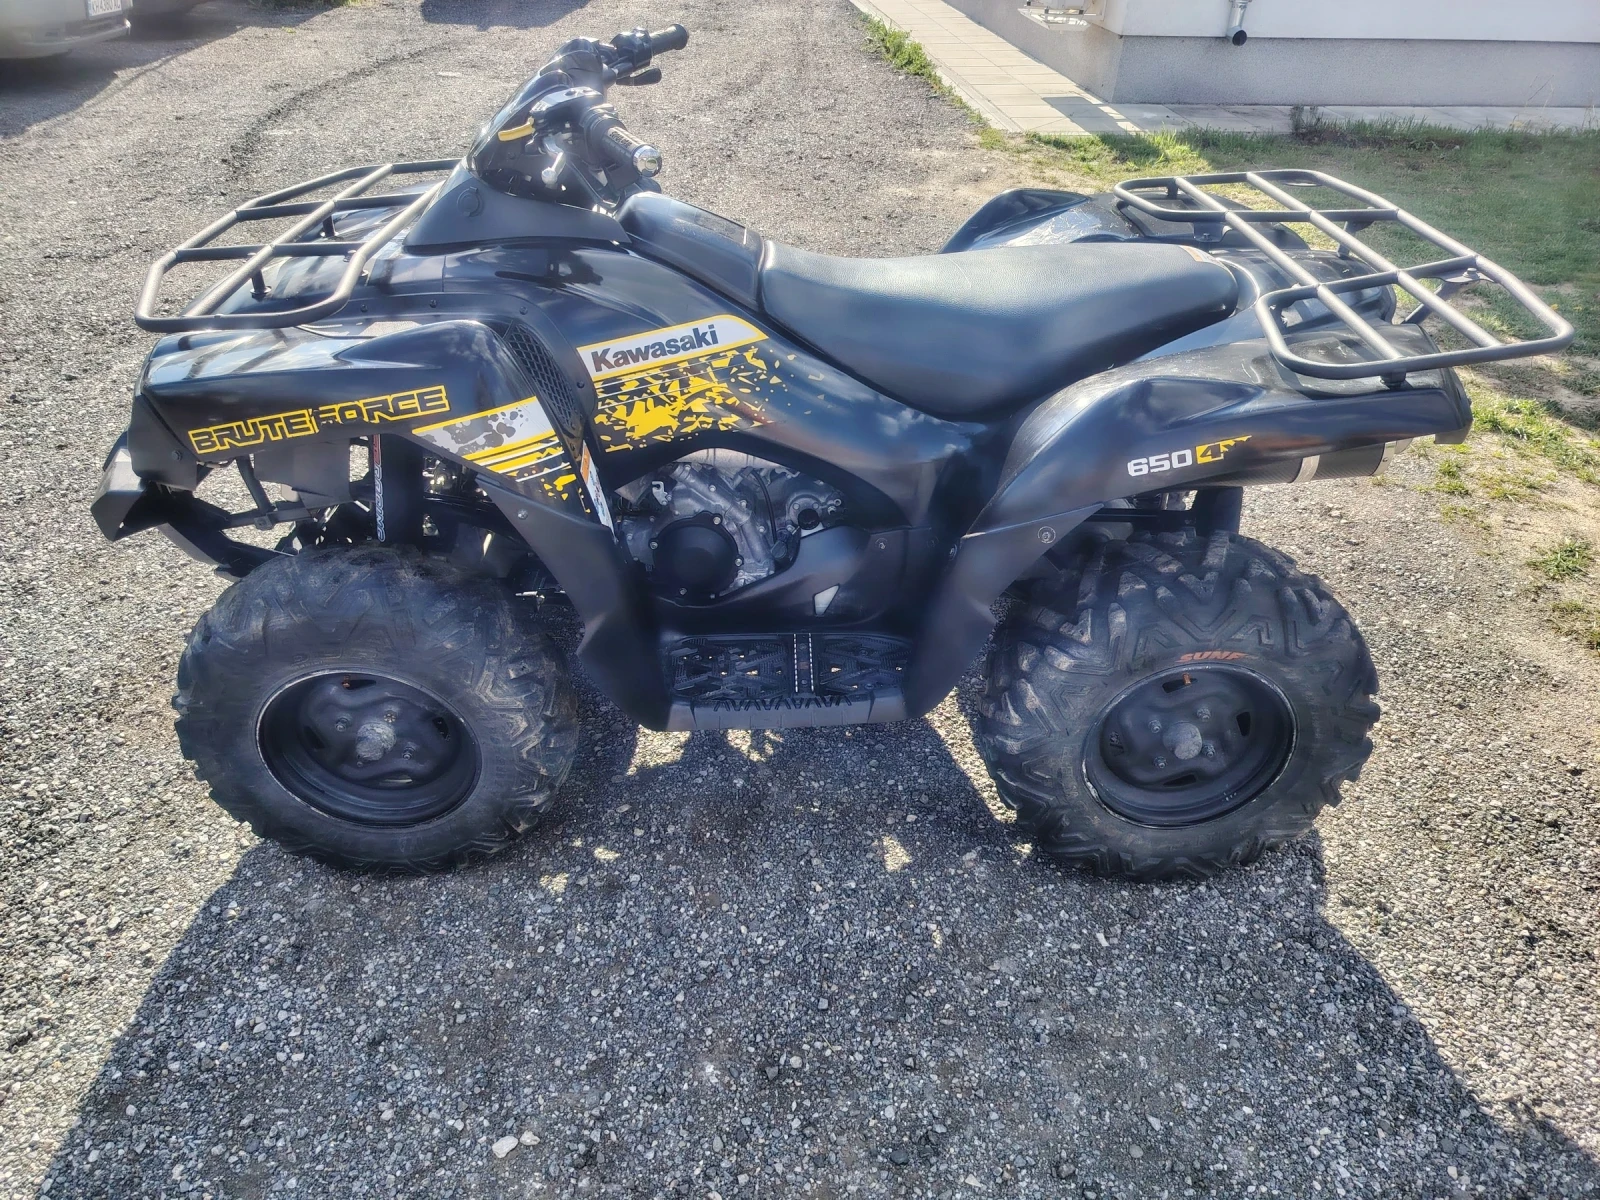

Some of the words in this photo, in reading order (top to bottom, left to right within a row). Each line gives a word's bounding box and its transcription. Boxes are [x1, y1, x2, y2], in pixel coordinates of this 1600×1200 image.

[591, 324, 719, 373] Kawasaki
[188, 409, 317, 454] BRUTE
[310, 385, 451, 434] FORCE
[1127, 449, 1193, 477] 650
